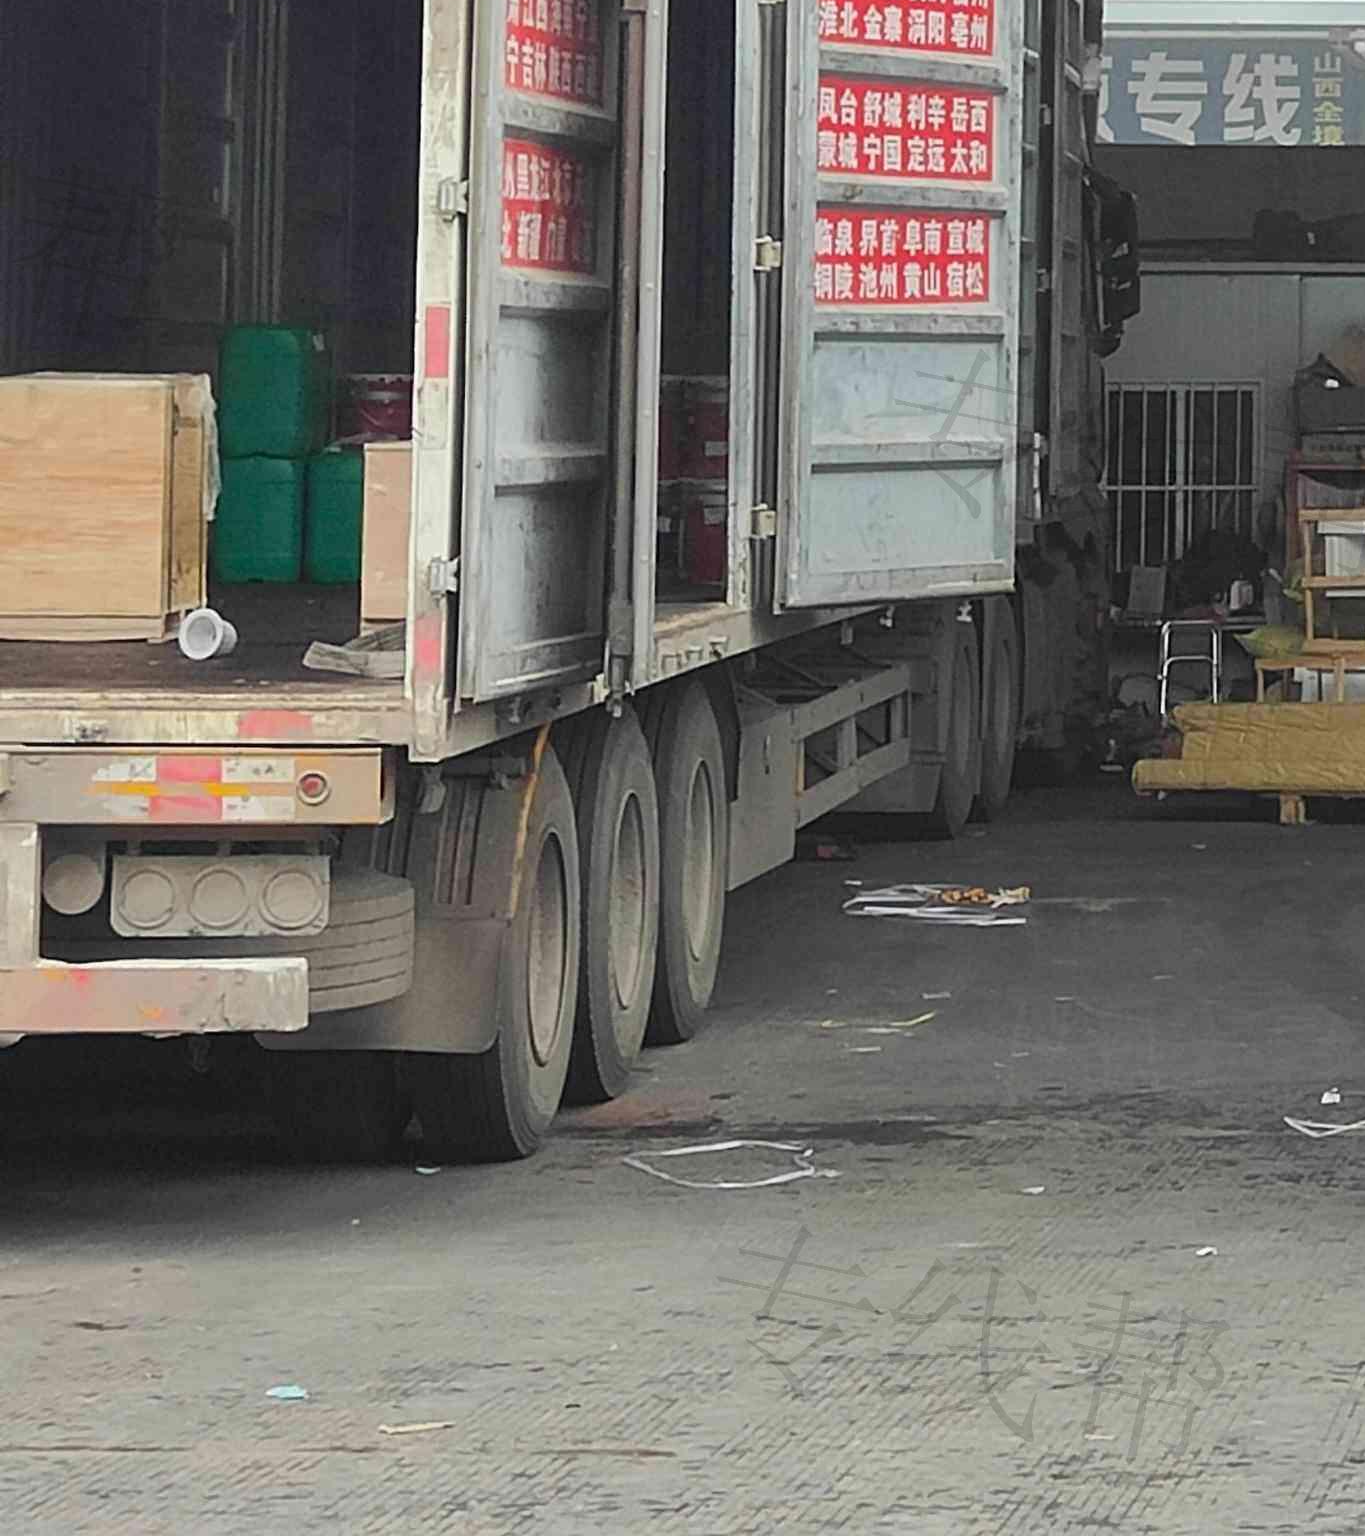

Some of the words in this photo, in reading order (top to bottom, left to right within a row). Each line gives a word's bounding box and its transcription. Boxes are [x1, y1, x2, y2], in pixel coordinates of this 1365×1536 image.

[863, 132, 902, 171] 宁国
[950, 139, 988, 174] 太和
[902, 264, 941, 299] 黄山
